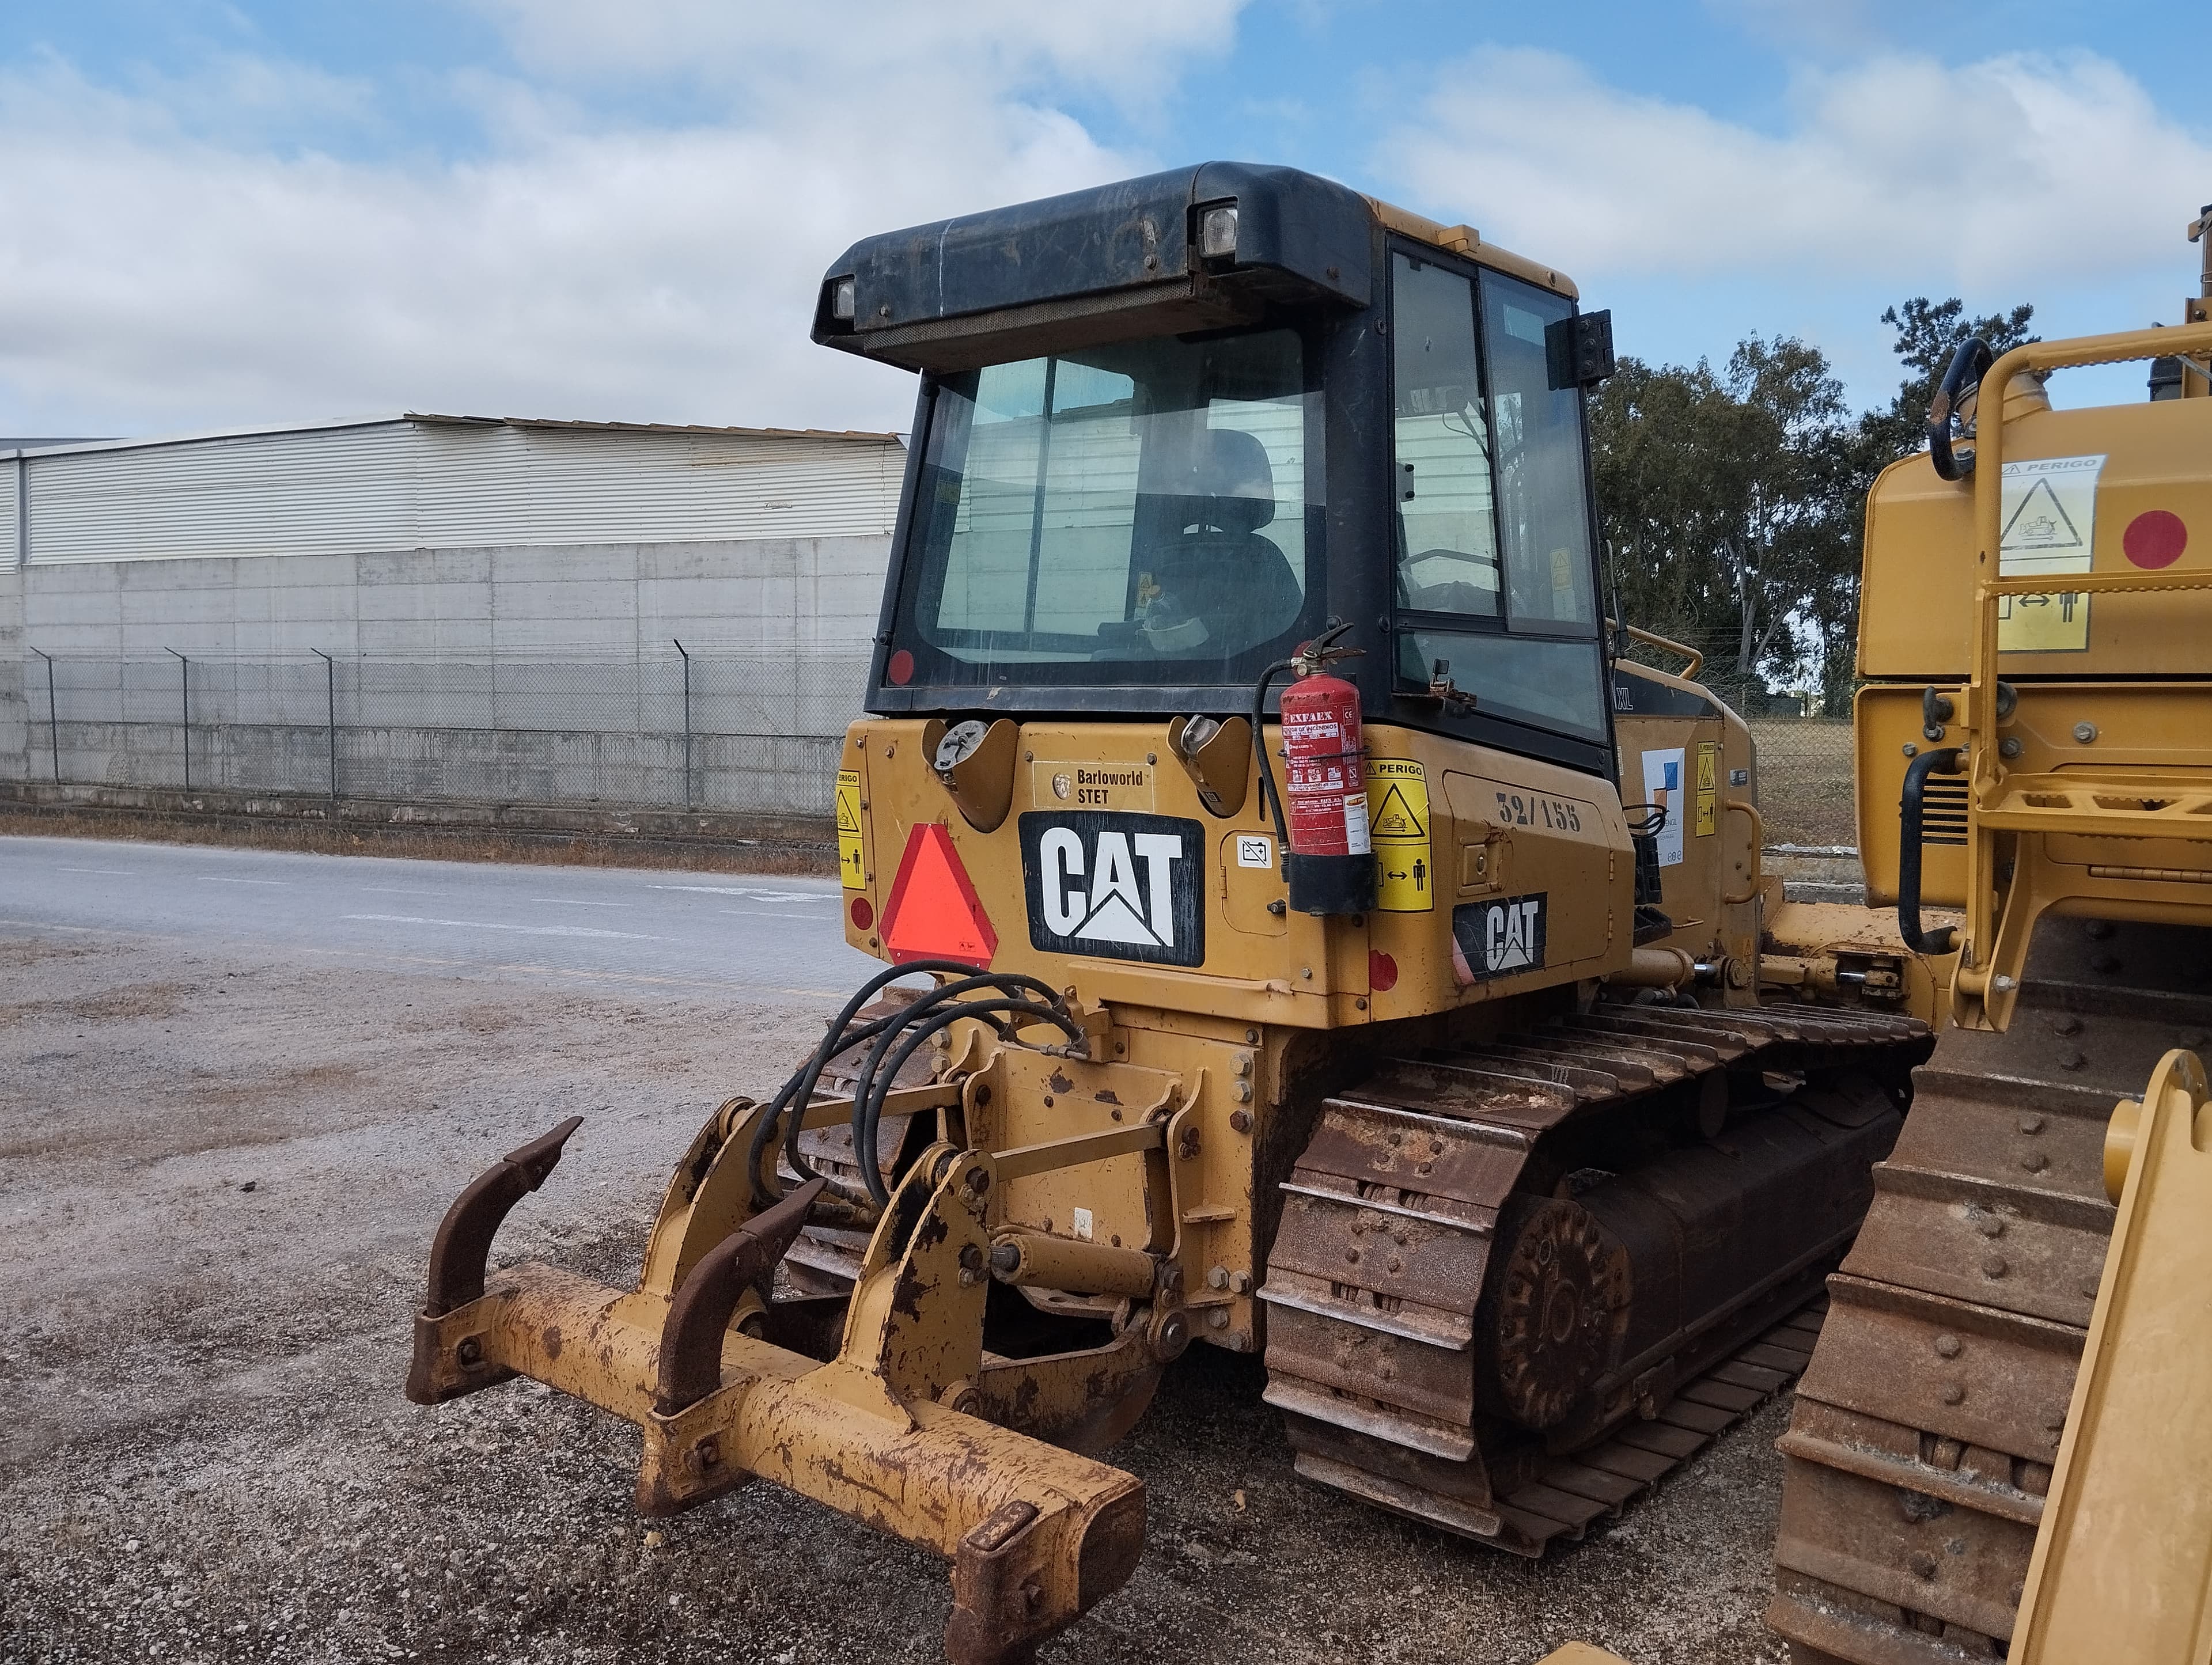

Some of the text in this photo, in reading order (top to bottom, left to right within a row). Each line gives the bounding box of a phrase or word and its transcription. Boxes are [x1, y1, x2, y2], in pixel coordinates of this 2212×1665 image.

[2027, 459, 2096, 472] PERIGO
[1344, 711, 1353, 719] CE
[839, 774, 857, 782] ERIGO
[1077, 769, 1143, 786] Barloworld
[1379, 764, 1422, 776] PERIGO
[1078, 788, 1108, 804] STET
[1496, 792, 1581, 832] 32/155
[1040, 827, 1182, 947] CAT
[1486, 900, 1539, 971] CAT
